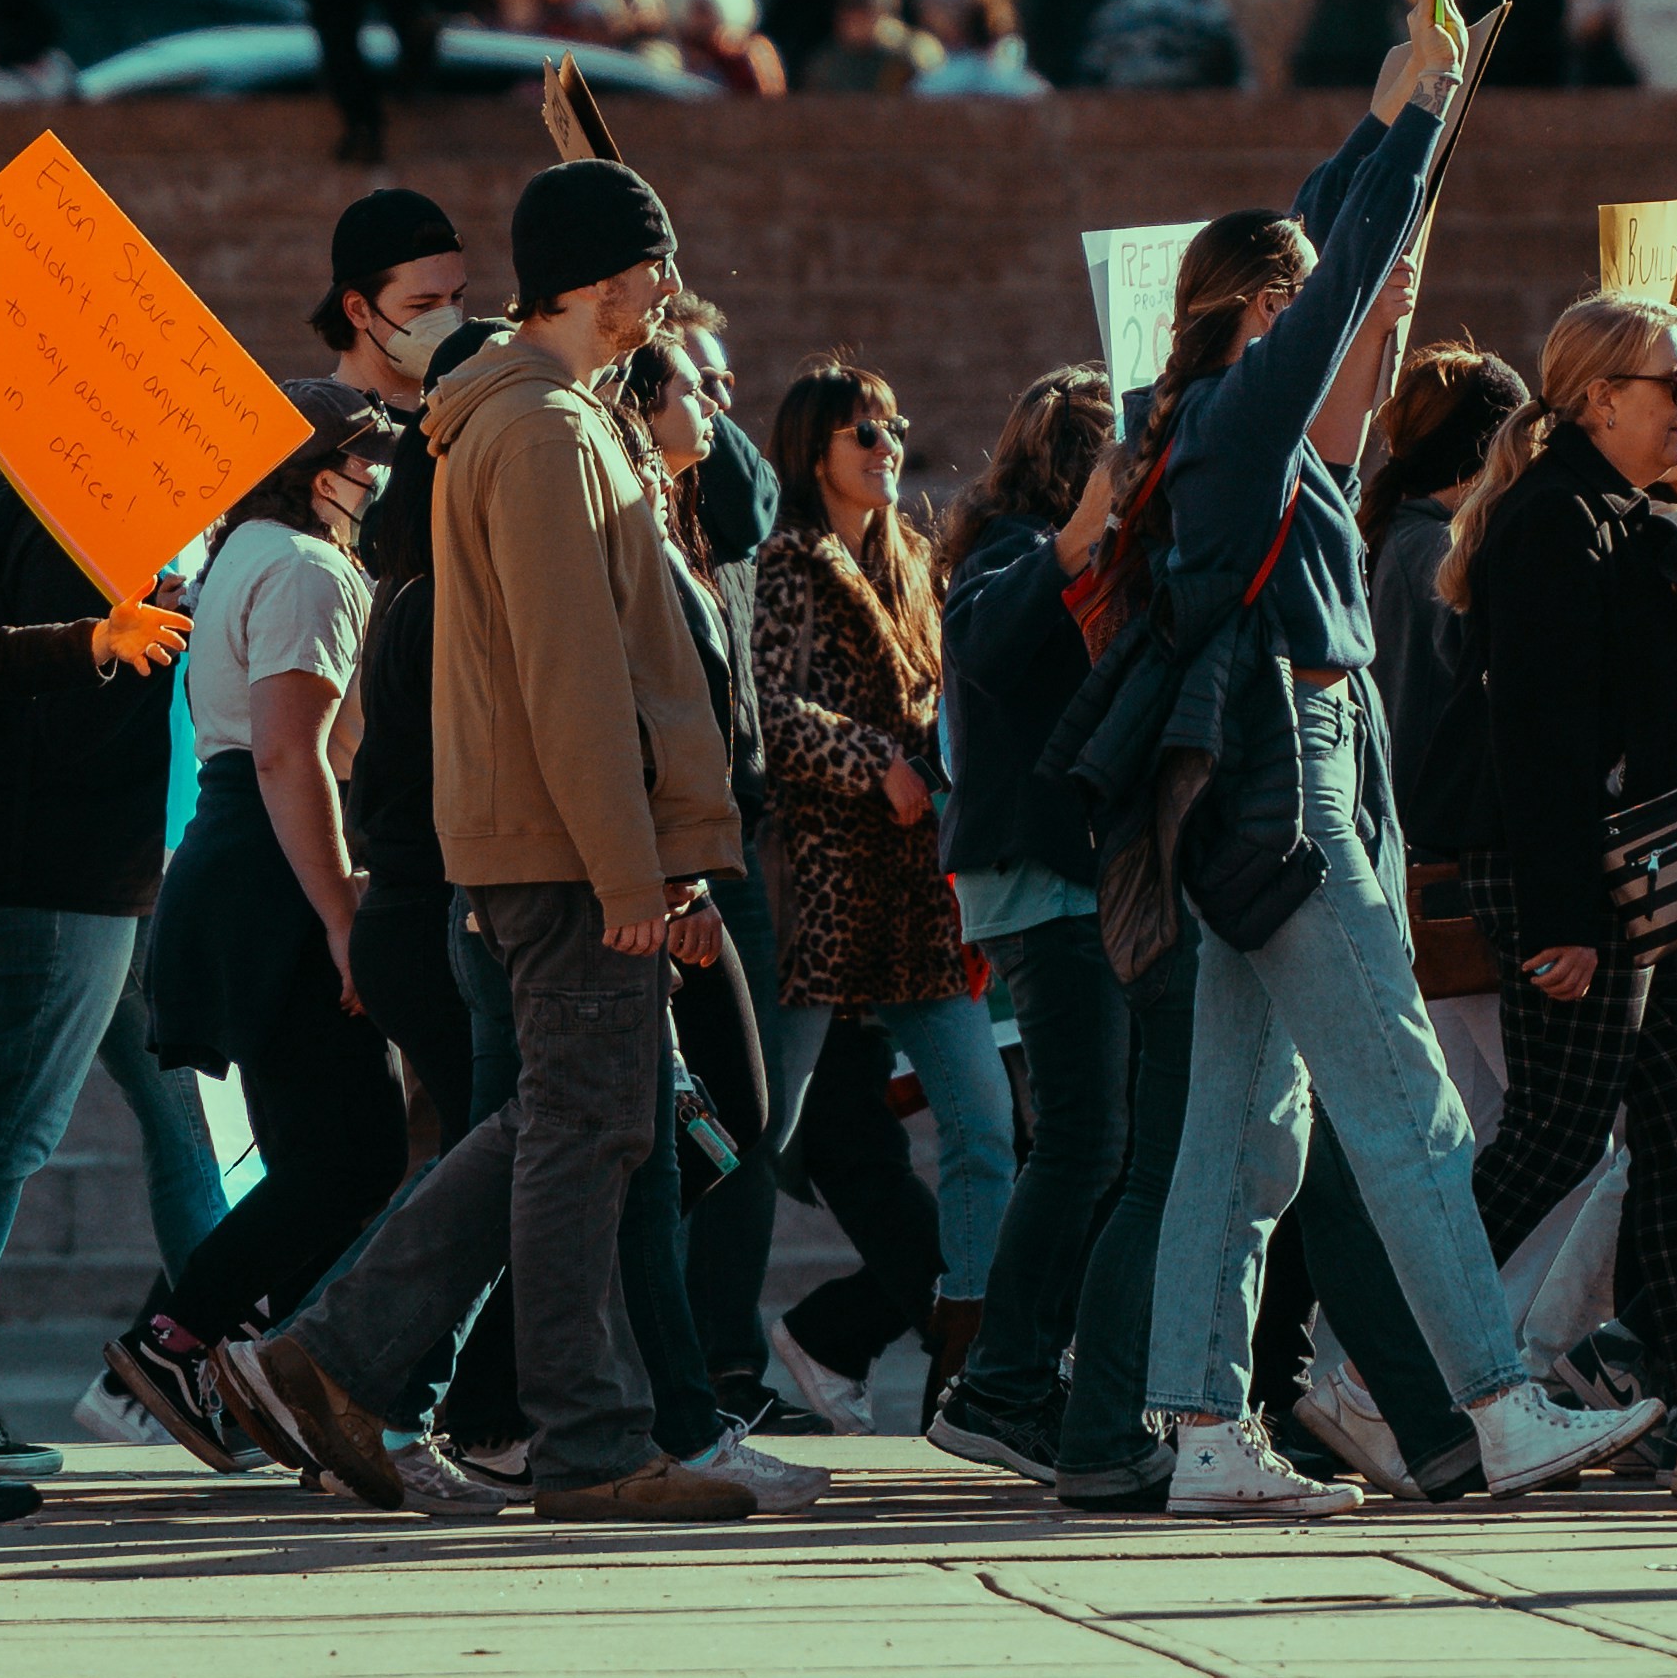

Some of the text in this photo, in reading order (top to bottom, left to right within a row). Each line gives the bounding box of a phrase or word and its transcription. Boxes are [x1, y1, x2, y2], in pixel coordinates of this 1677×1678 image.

[3, 375, 25, 412] in
[36, 157, 261, 436] Even Steve Irwin
[5, 297, 28, 329] to
[36, 332, 69, 386] say
[73, 379, 139, 447] about
[151, 458, 187, 508] the
[98, 313, 145, 372] find
[142, 374, 232, 501] anything
